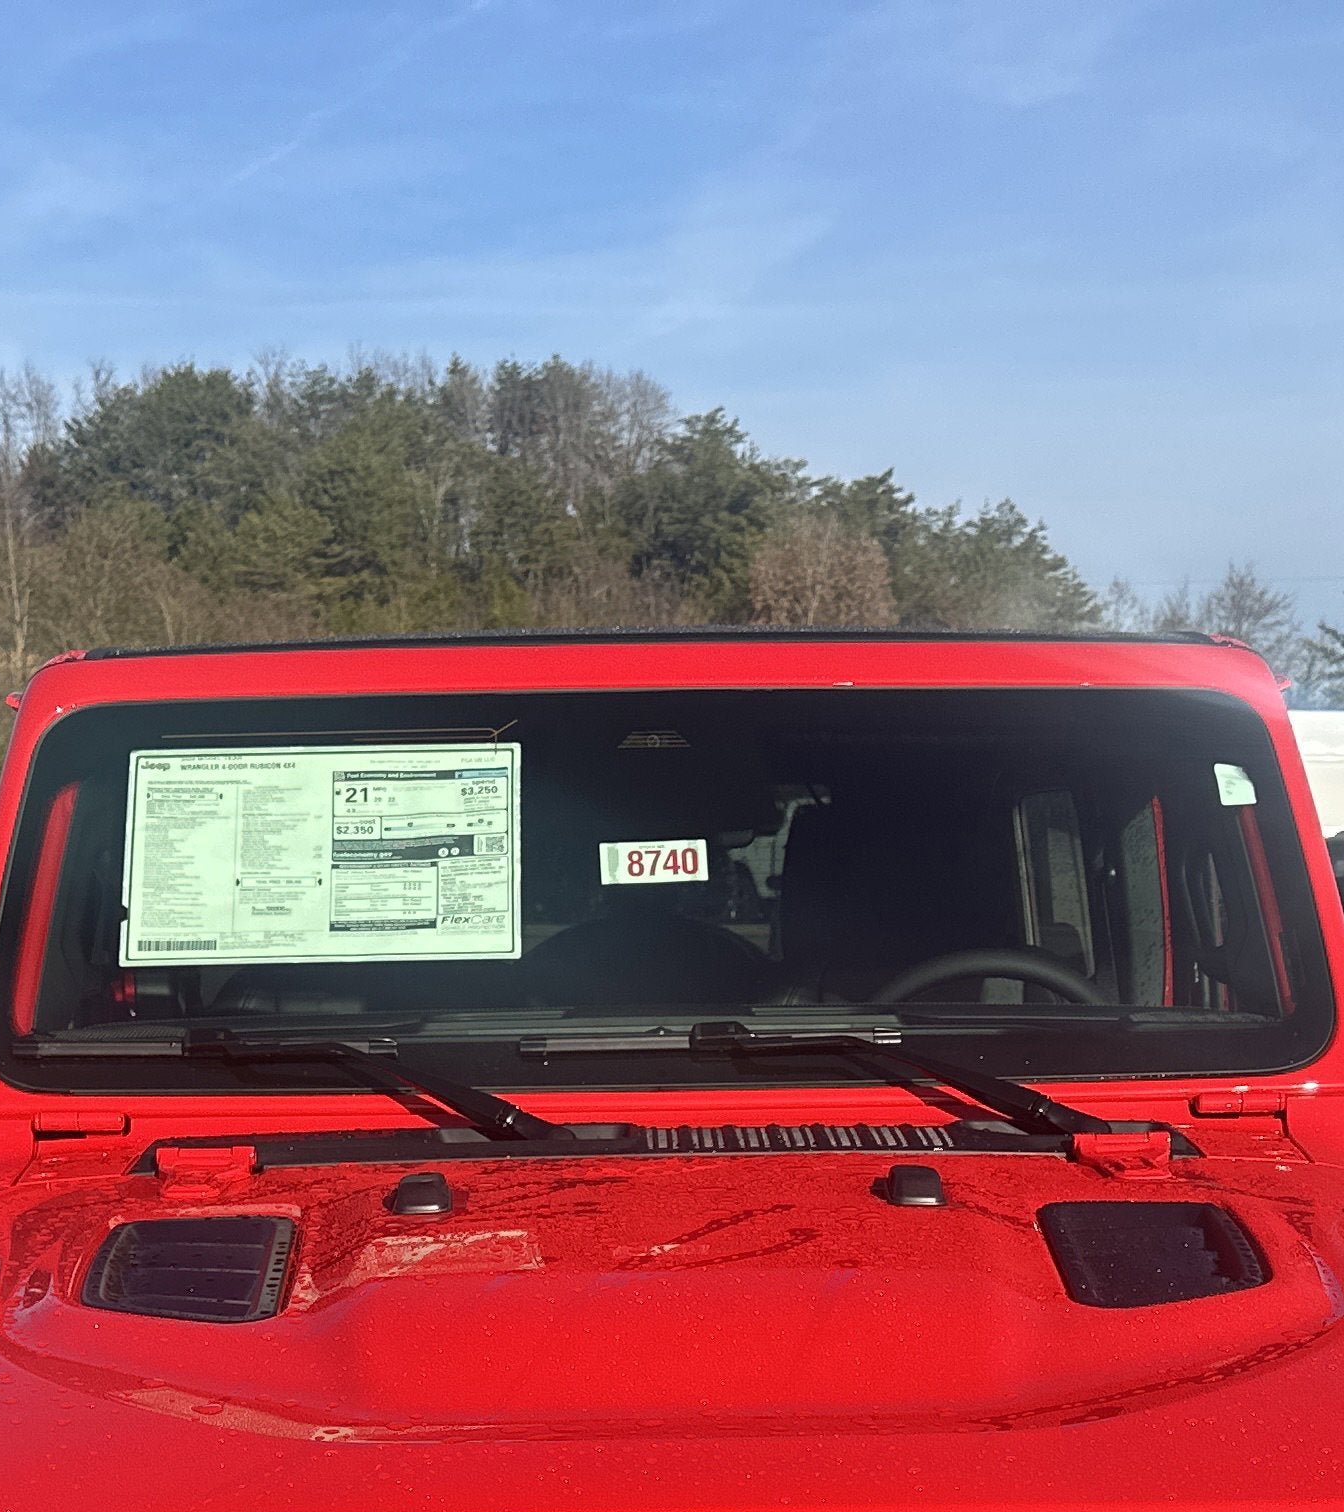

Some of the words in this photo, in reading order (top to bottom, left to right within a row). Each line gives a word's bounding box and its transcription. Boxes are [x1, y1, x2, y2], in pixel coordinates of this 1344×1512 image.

[141, 761, 171, 771] Jeep
[180, 763, 219, 771] WRANGLER
[345, 787, 368, 803] 21
[460, 785, 498, 797] $3,250
[626, 847, 699, 877] 8740
[441, 914, 506, 925] FlexCare
